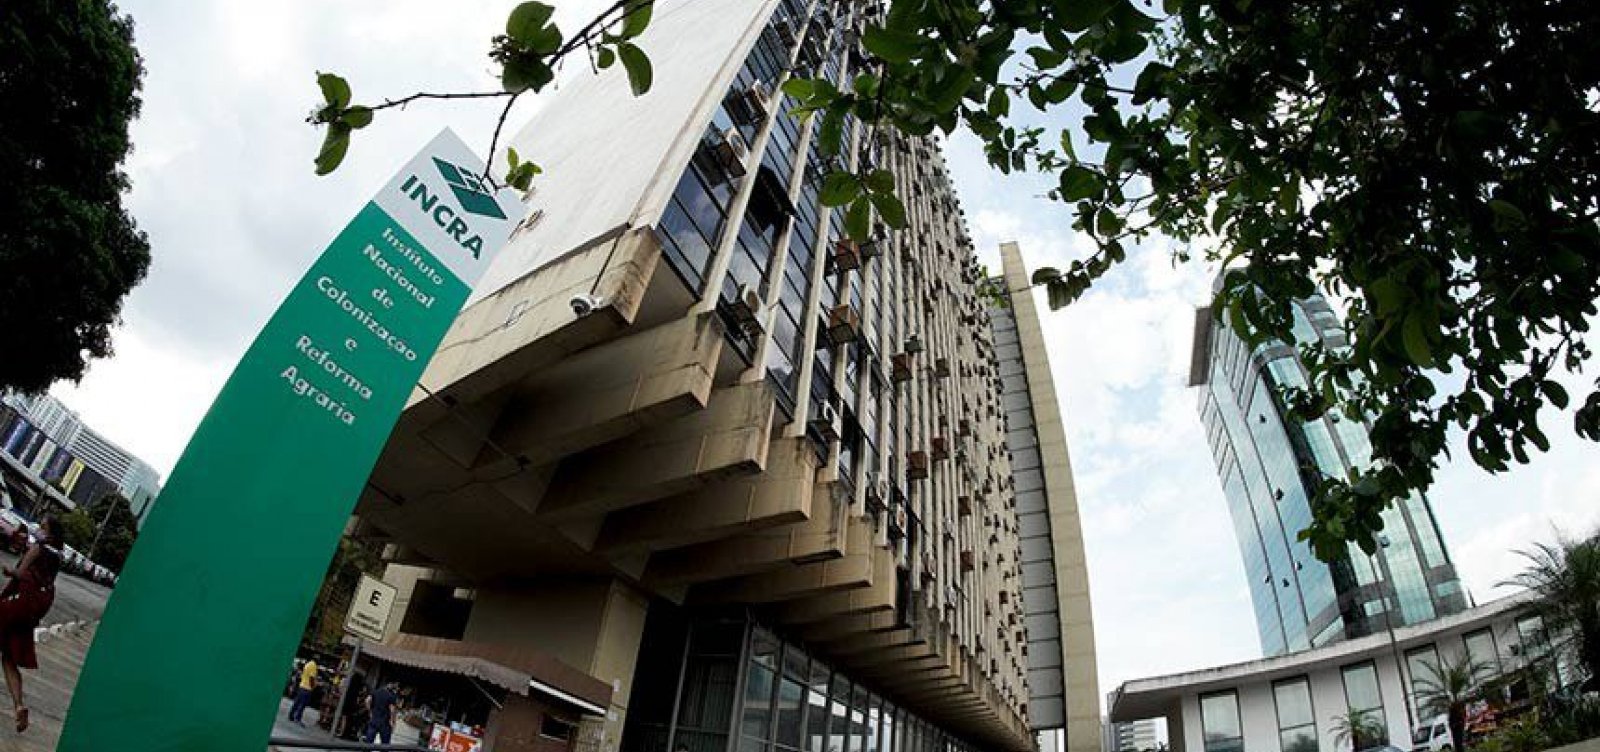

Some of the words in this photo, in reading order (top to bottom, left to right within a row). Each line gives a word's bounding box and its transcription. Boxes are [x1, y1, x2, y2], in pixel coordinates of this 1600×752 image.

[400, 174, 483, 260] INCRA
[363, 244, 435, 309] Nacional
[382, 227, 444, 285] Instituto
[371, 288, 394, 309] de
[295, 335, 373, 400] Reforma
[345, 338, 358, 351] e
[369, 590, 382, 607] E
